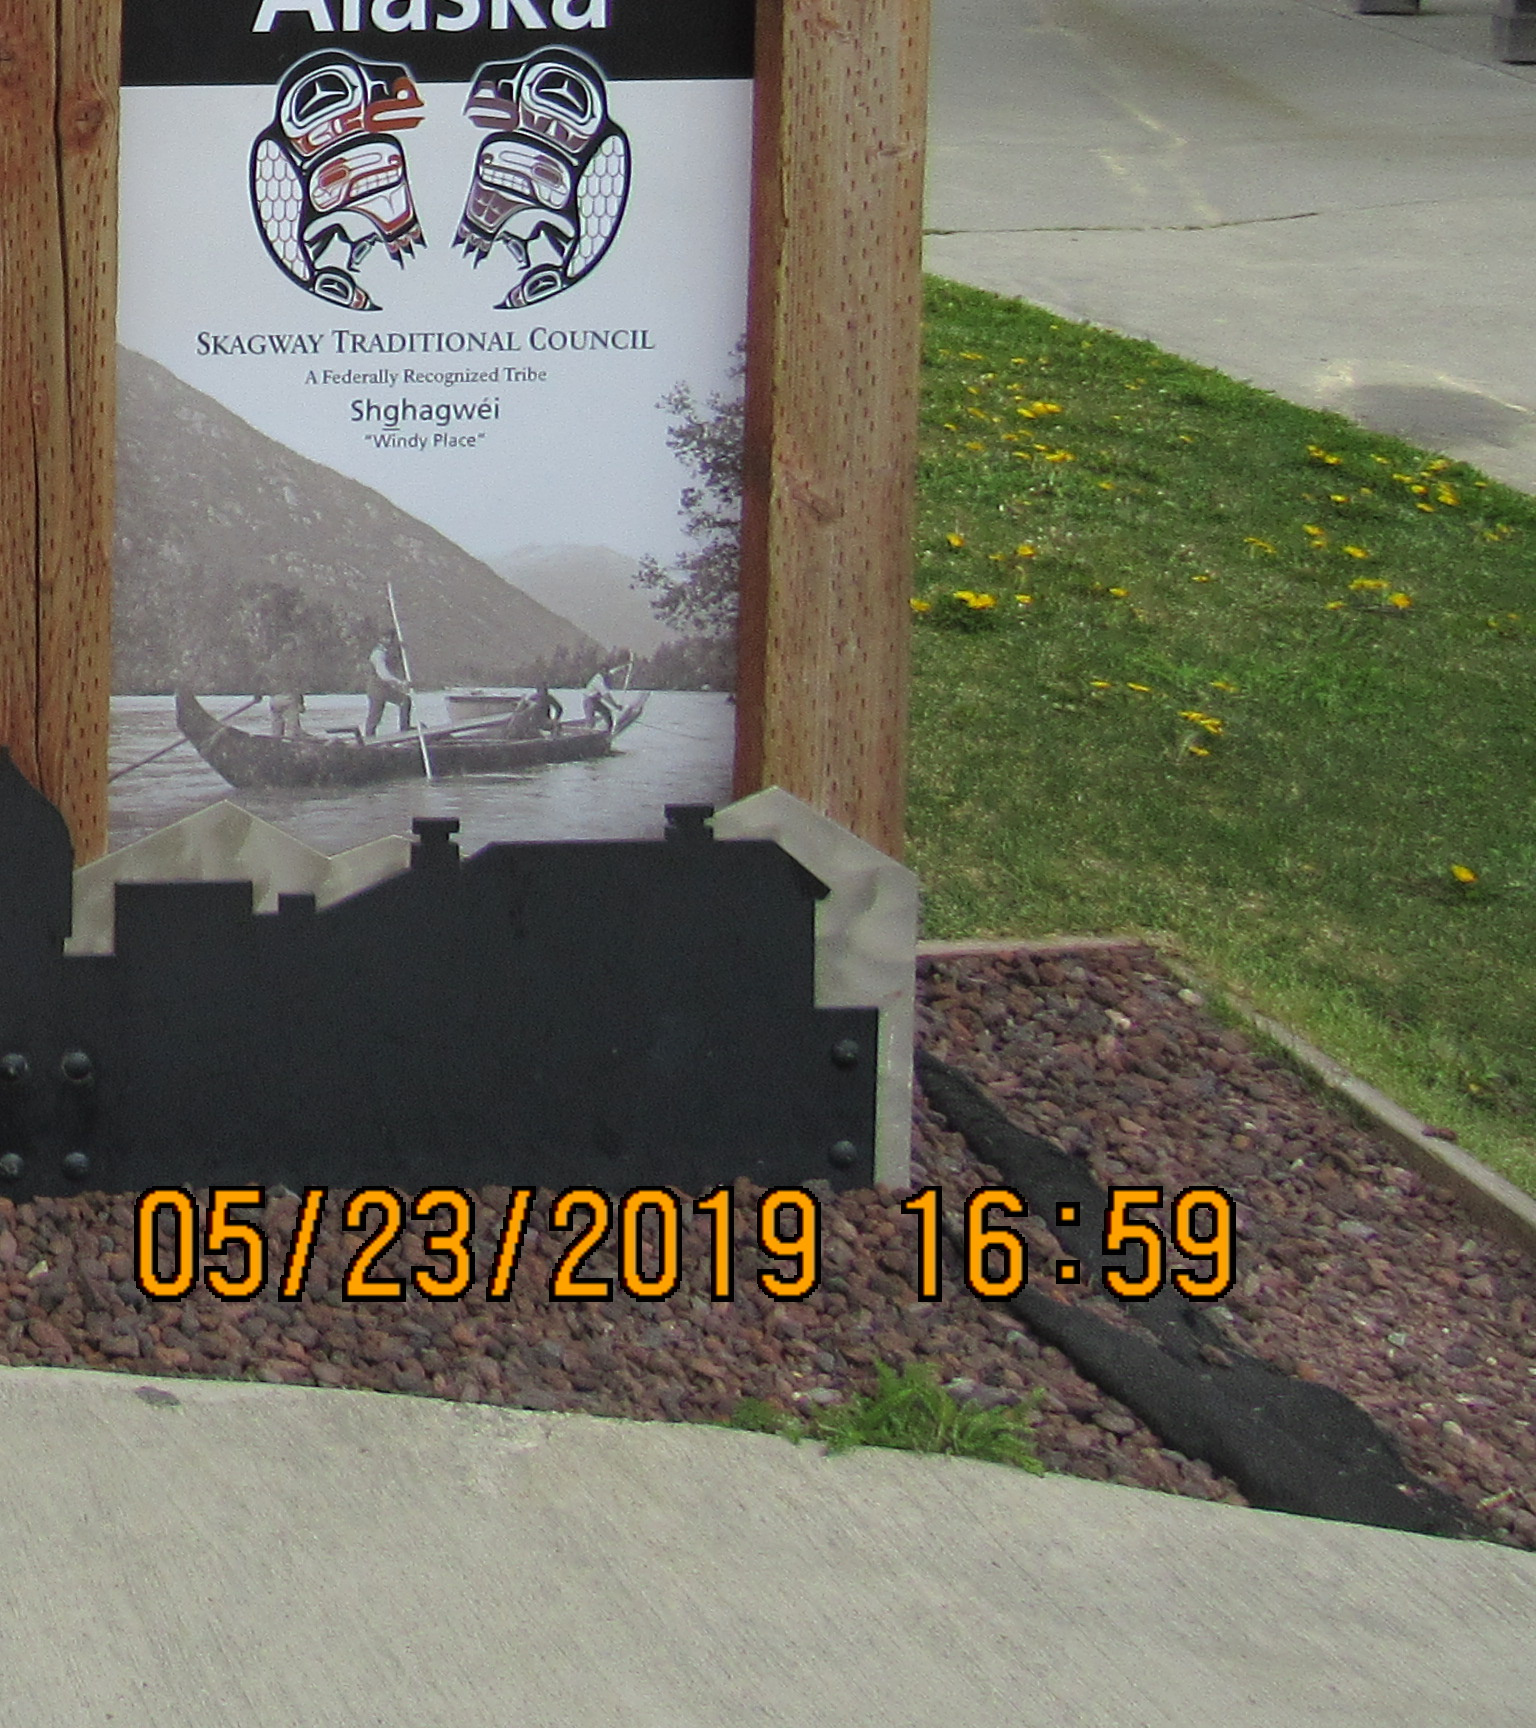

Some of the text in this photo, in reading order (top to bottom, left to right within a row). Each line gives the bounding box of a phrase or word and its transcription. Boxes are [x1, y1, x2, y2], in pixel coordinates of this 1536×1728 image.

[196, 327, 656, 357] SKAGWAY TRADITIONAL COUNCIL
[305, 367, 548, 387] A Federally Recognized Tribe
